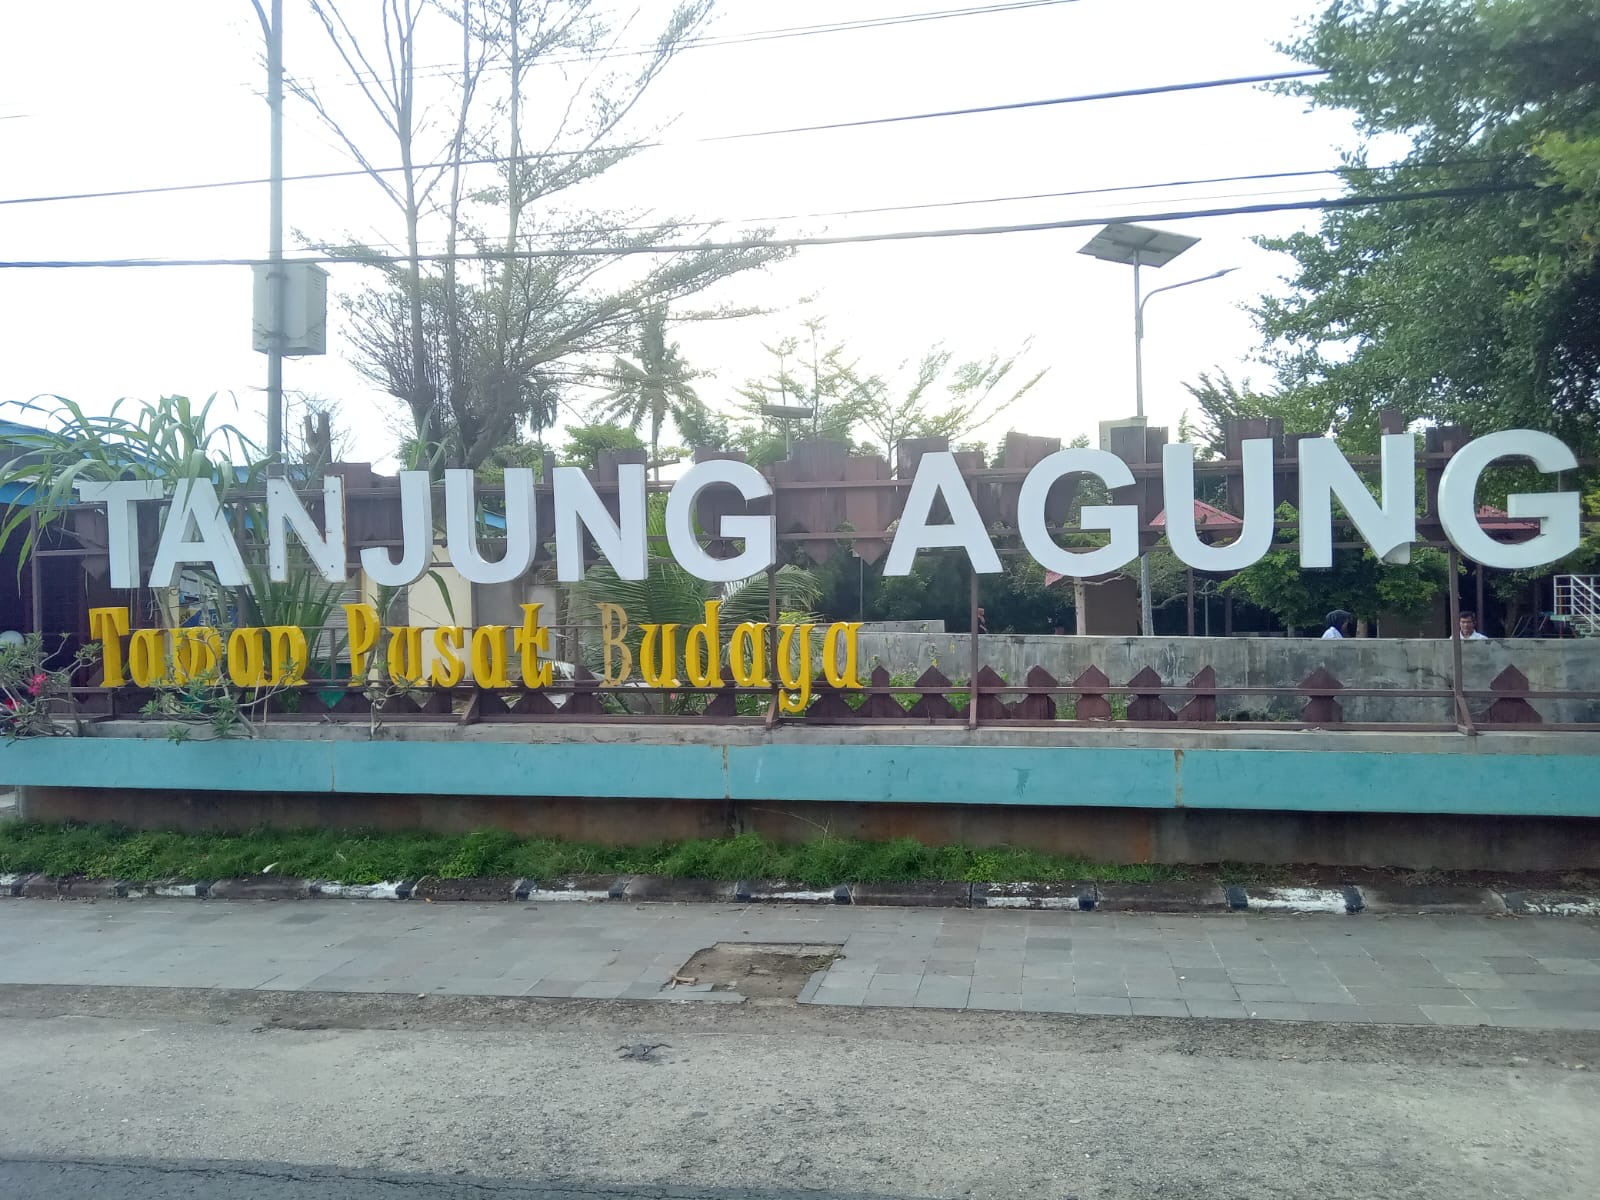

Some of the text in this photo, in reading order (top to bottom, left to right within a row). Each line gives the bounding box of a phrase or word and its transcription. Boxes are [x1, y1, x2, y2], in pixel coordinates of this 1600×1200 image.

[79, 429, 1581, 589] TANJUNG AGUNG
[89, 600, 864, 713] Taman Pusat Budaya
